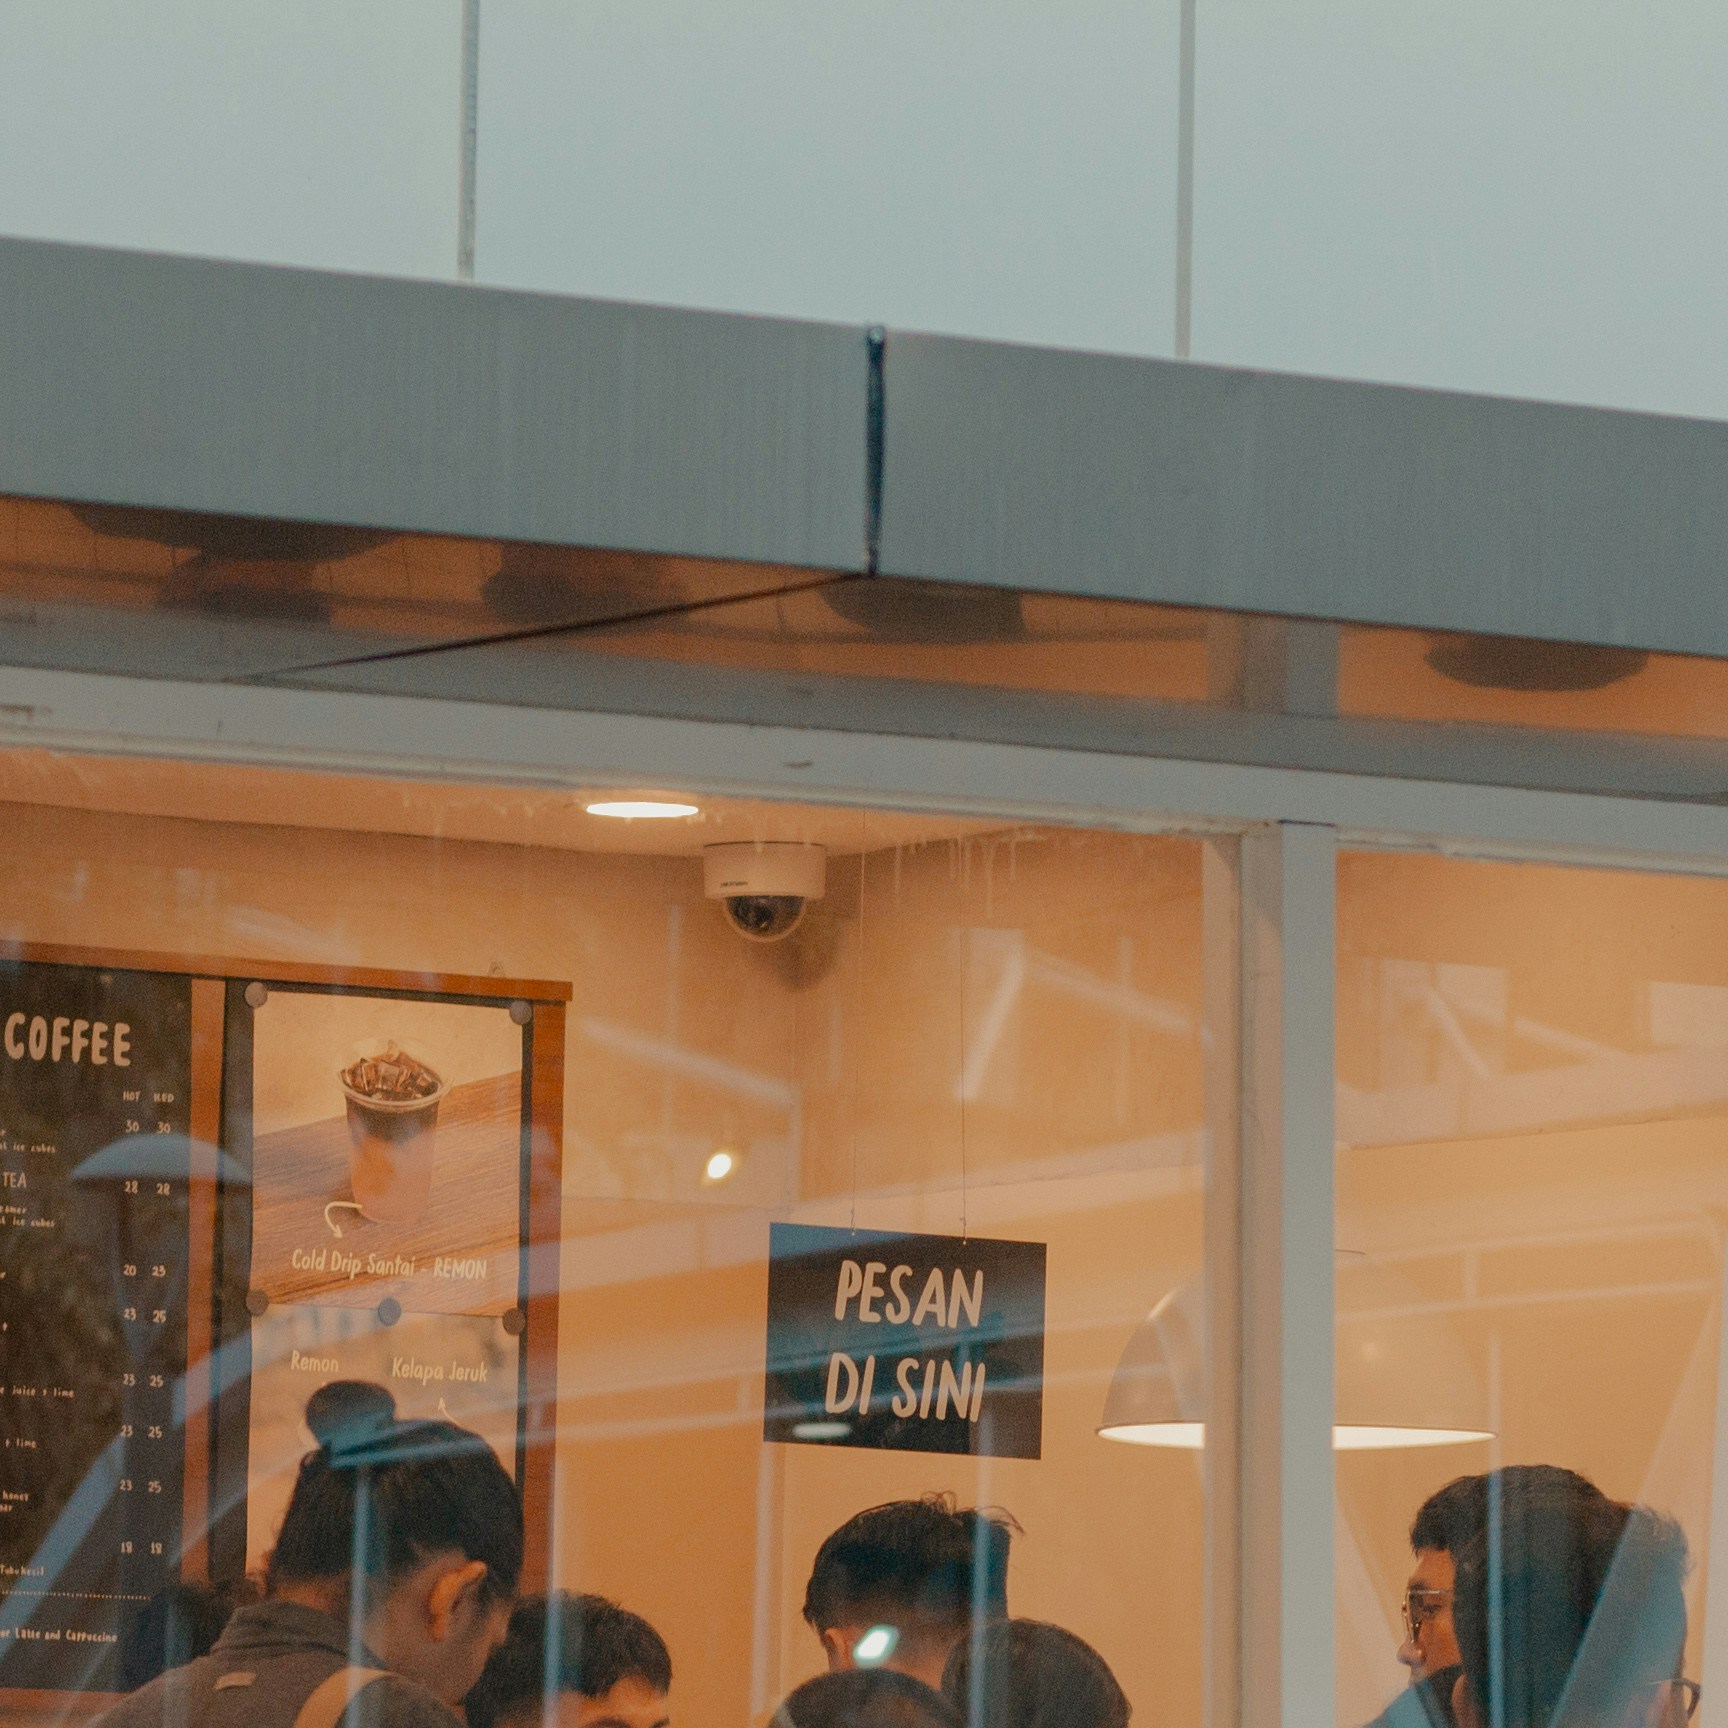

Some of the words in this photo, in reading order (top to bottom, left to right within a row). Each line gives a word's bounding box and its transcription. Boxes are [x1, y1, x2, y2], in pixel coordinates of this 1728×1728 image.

[122, 1091, 141, 1101] HOT
[126, 1120, 139, 1132] 30
[157, 1122, 171, 1134] 30
[3, 1171, 27, 1188] TEA
[125, 1181, 138, 1193] 28
[156, 1183, 170, 1195] 28
[124, 1264, 137, 1276] 20
[152, 1265, 166, 1277] 23
[292, 1249, 325, 1271] Cold
[332, 1251, 361, 1280] Drip
[367, 1254, 414, 1276] Santai
[434, 1257, 487, 1279] REMON
[835, 1260, 984, 1329] PESAN
[124, 1309, 137, 1321] 23
[153, 1311, 166, 1323] 25
[291, 1350, 338, 1372] Remon
[392, 1357, 443, 1385] Kelapa
[449, 1360, 488, 1382] Jeruk
[123, 1374, 136, 1386] 23
[150, 1376, 163, 1387] 25
[825, 1352, 876, 1415] DI
[892, 1358, 986, 1423] SINI
[121, 1425, 133, 1437] 23
[148, 1426, 162, 1438] 25
[120, 1479, 132, 1492] 23
[148, 1481, 161, 1493] 25
[151, 1542, 162, 1554] 18
